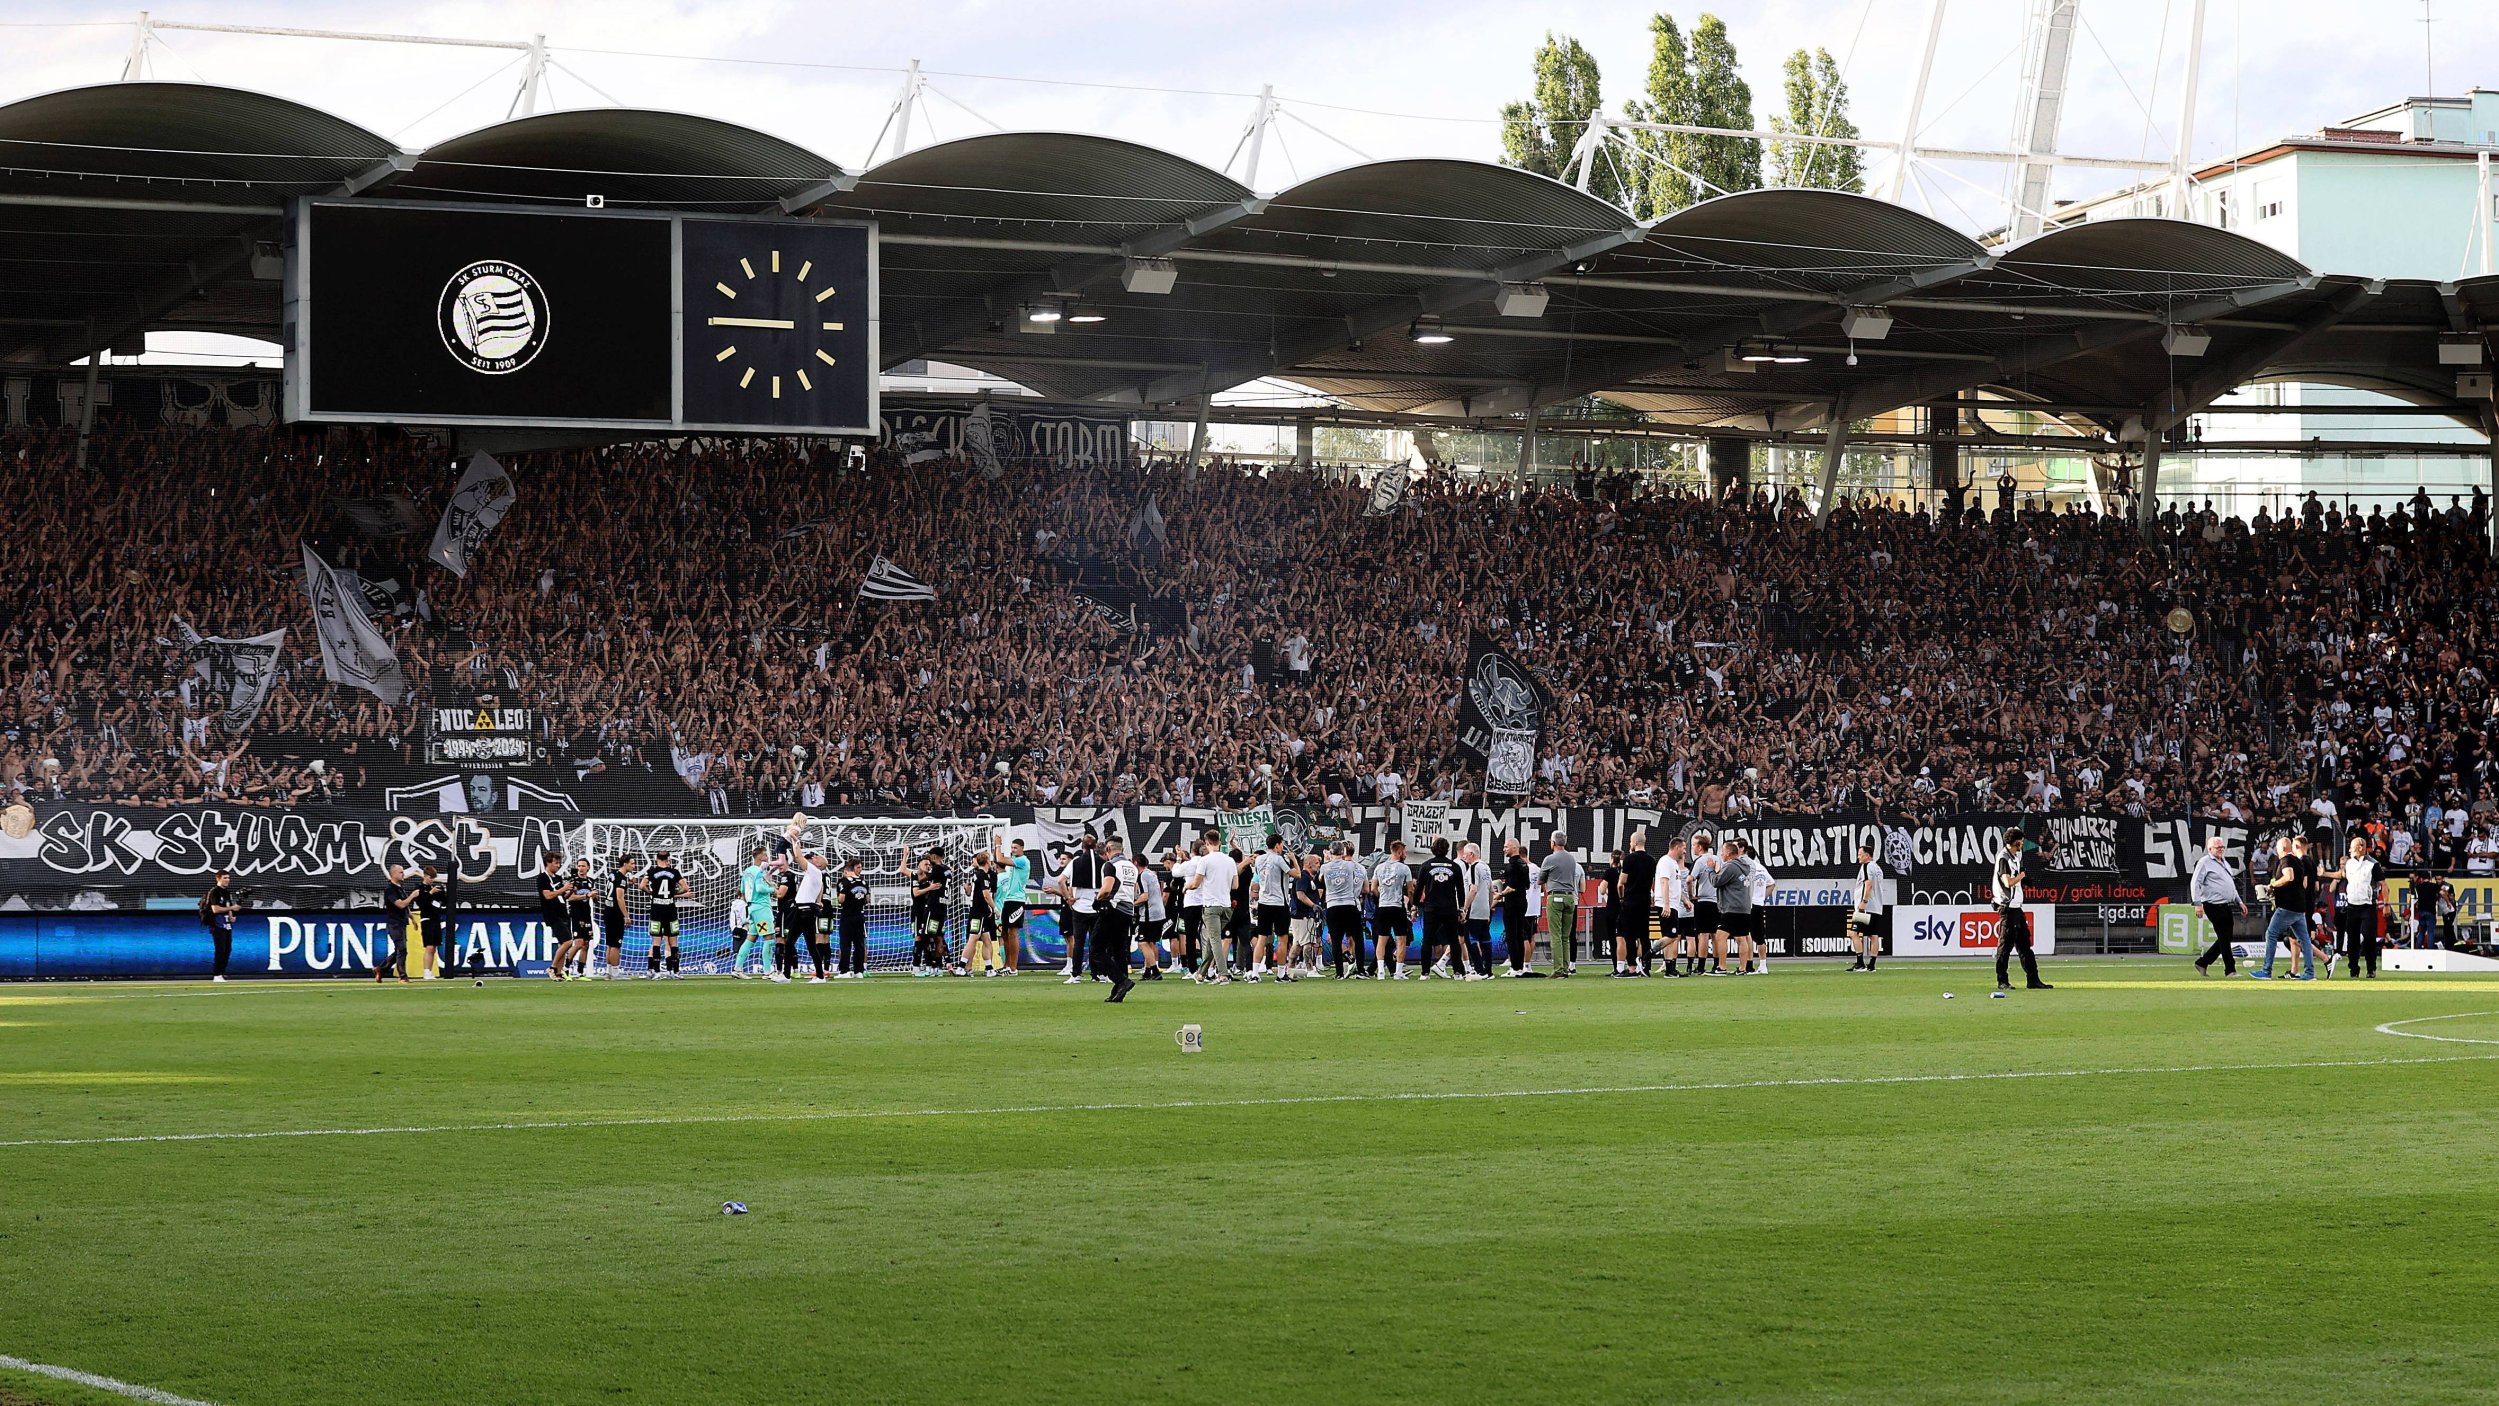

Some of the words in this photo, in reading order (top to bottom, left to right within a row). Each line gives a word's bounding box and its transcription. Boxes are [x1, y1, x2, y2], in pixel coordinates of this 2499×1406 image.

[458, 273, 470, 285] SK
[472, 265, 503, 276] STURM
[506, 268, 532, 289] GRAZ
[471, 356, 491, 369] SEIT
[494, 358, 516, 370] 1909
[1407, 803, 1446, 820] GRAZER
[1411, 818, 1443, 834] STURM
[39, 810, 144, 876] SK
[1414, 834, 1441, 848] FLU
[1912, 825, 2002, 865] CHAO
[657, 879, 671, 899] 4
[1817, 889, 1856, 906] GRA
[2071, 884, 2104, 900] grafik
[2113, 885, 2146, 899] druck
[2098, 903, 2146, 924] bgd.at
[1913, 914, 1956, 947] sky
